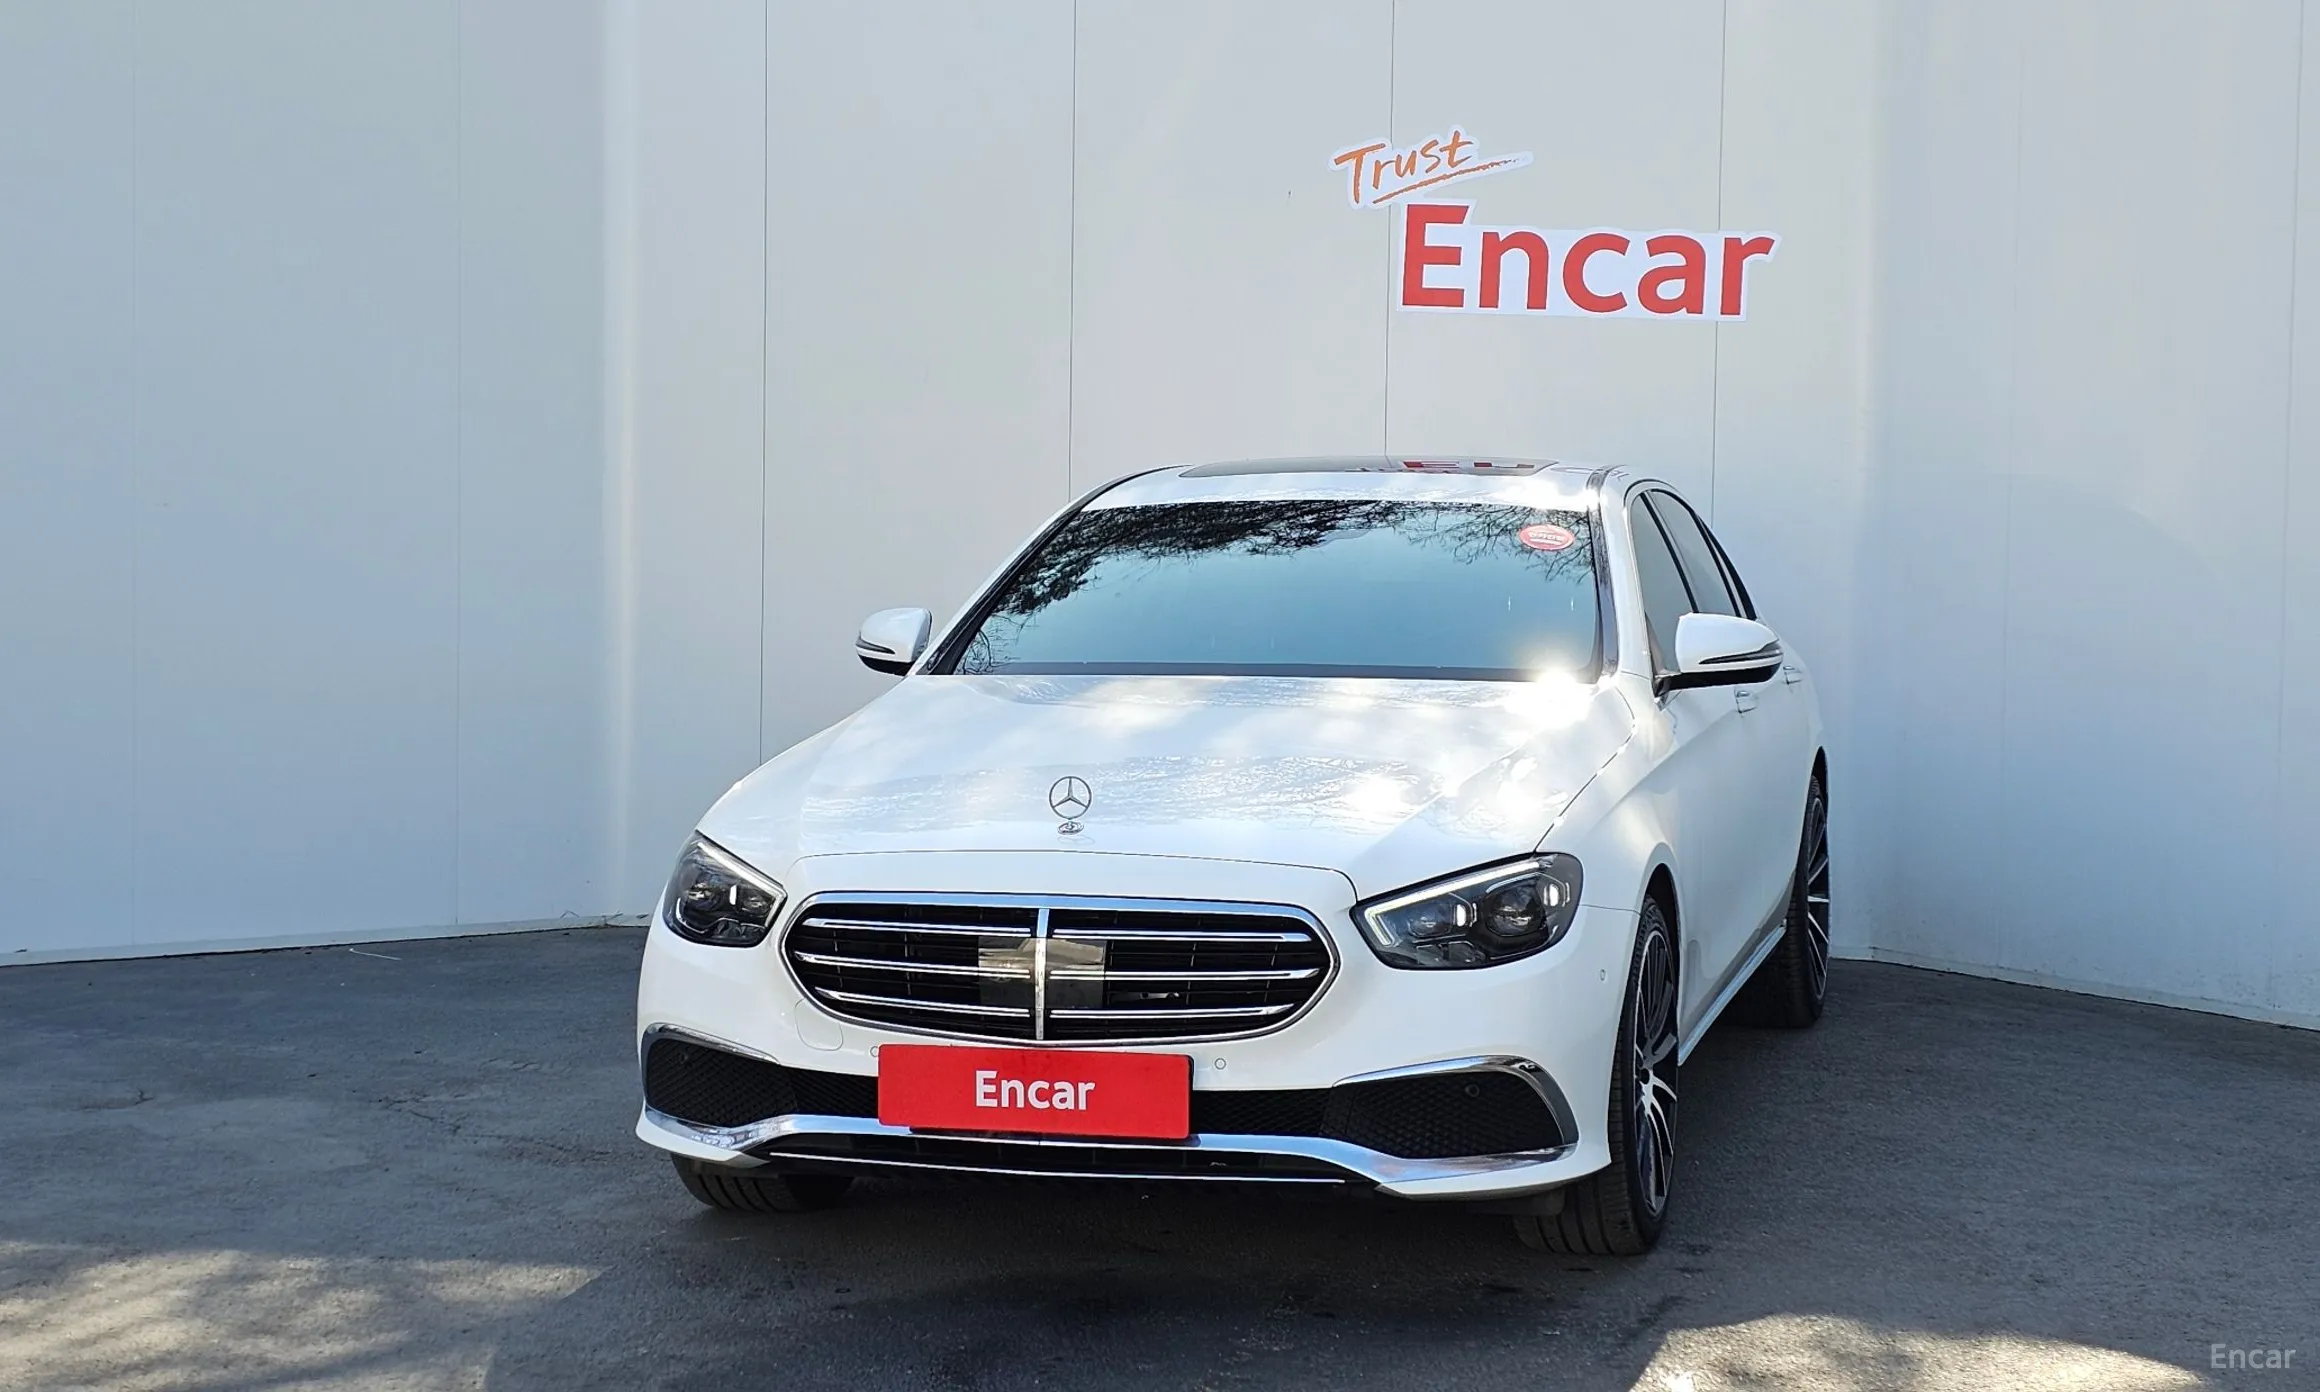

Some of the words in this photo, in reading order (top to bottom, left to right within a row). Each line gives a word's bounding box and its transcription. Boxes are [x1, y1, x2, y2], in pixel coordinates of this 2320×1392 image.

[1334, 130, 1474, 204] Trust
[1402, 204, 1775, 316] Encar
[974, 1070, 1095, 1110] Encar
